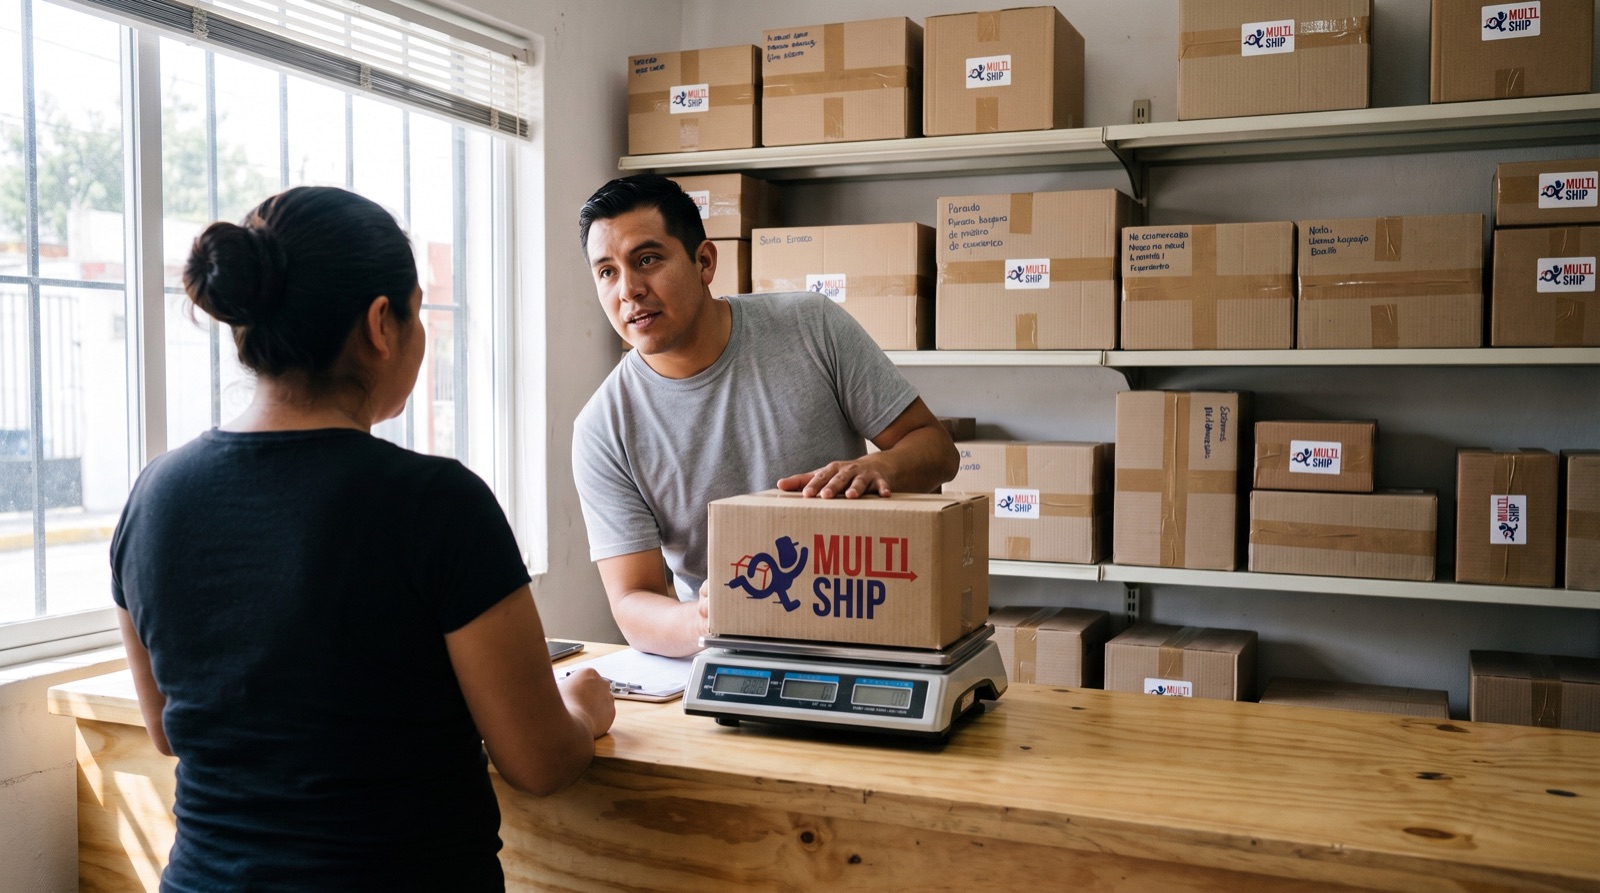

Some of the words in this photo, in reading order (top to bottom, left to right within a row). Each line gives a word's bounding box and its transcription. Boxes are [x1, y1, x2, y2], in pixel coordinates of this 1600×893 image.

[1509, 7, 1539, 20] MULTI
[1266, 25, 1293, 38] MULTI
[1508, 20, 1531, 32] SHIP
[1265, 37, 1286, 48] SHIP
[986, 61, 1010, 72] MULTI
[986, 71, 1004, 82] SHIP
[687, 89, 708, 99] MULTI
[687, 99, 703, 107] SHIP
[1566, 178, 1597, 190] MULTI
[1565, 189, 1588, 201] SHIP
[1025, 264, 1049, 275] MULTI
[1563, 263, 1595, 275] MULTI
[824, 279, 845, 289] MULTI
[1025, 274, 1043, 284] SHIP
[1562, 274, 1586, 286] SHIP
[824, 288, 840, 298] SHIP
[1313, 447, 1339, 459] MULTI
[1312, 457, 1333, 468] SHIP
[1014, 494, 1038, 505] MULTI
[1014, 503, 1033, 513] SHIP
[1497, 495, 1509, 522] MULTI
[1508, 503, 1520, 522] SHIP
[813, 533, 919, 583] MULTI
[812, 576, 886, 620] SHIP
[1166, 685, 1190, 696] MULTI
